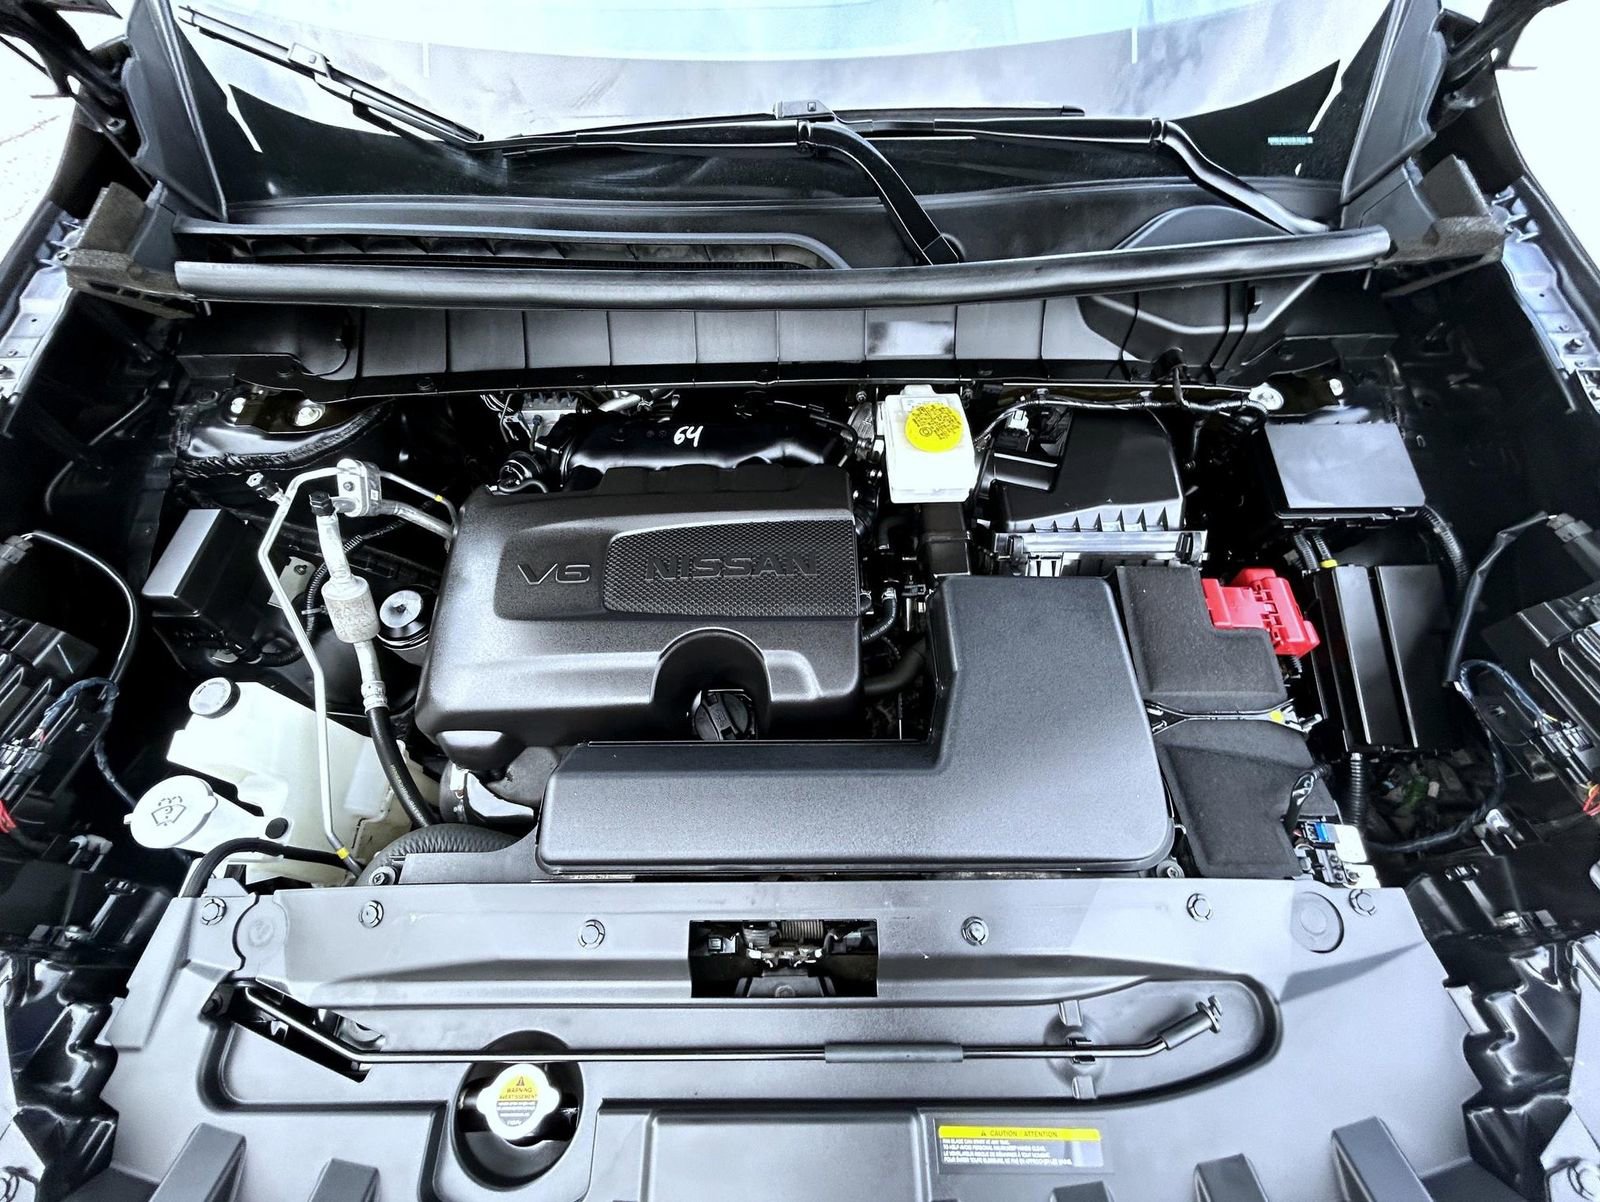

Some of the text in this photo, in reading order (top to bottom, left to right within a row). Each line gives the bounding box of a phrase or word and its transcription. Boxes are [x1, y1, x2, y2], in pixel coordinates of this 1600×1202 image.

[673, 425, 704, 448] 64
[518, 563, 591, 584] V6
[646, 554, 818, 580] NISSAN
[990, 1130, 1018, 1138] CAUTION
